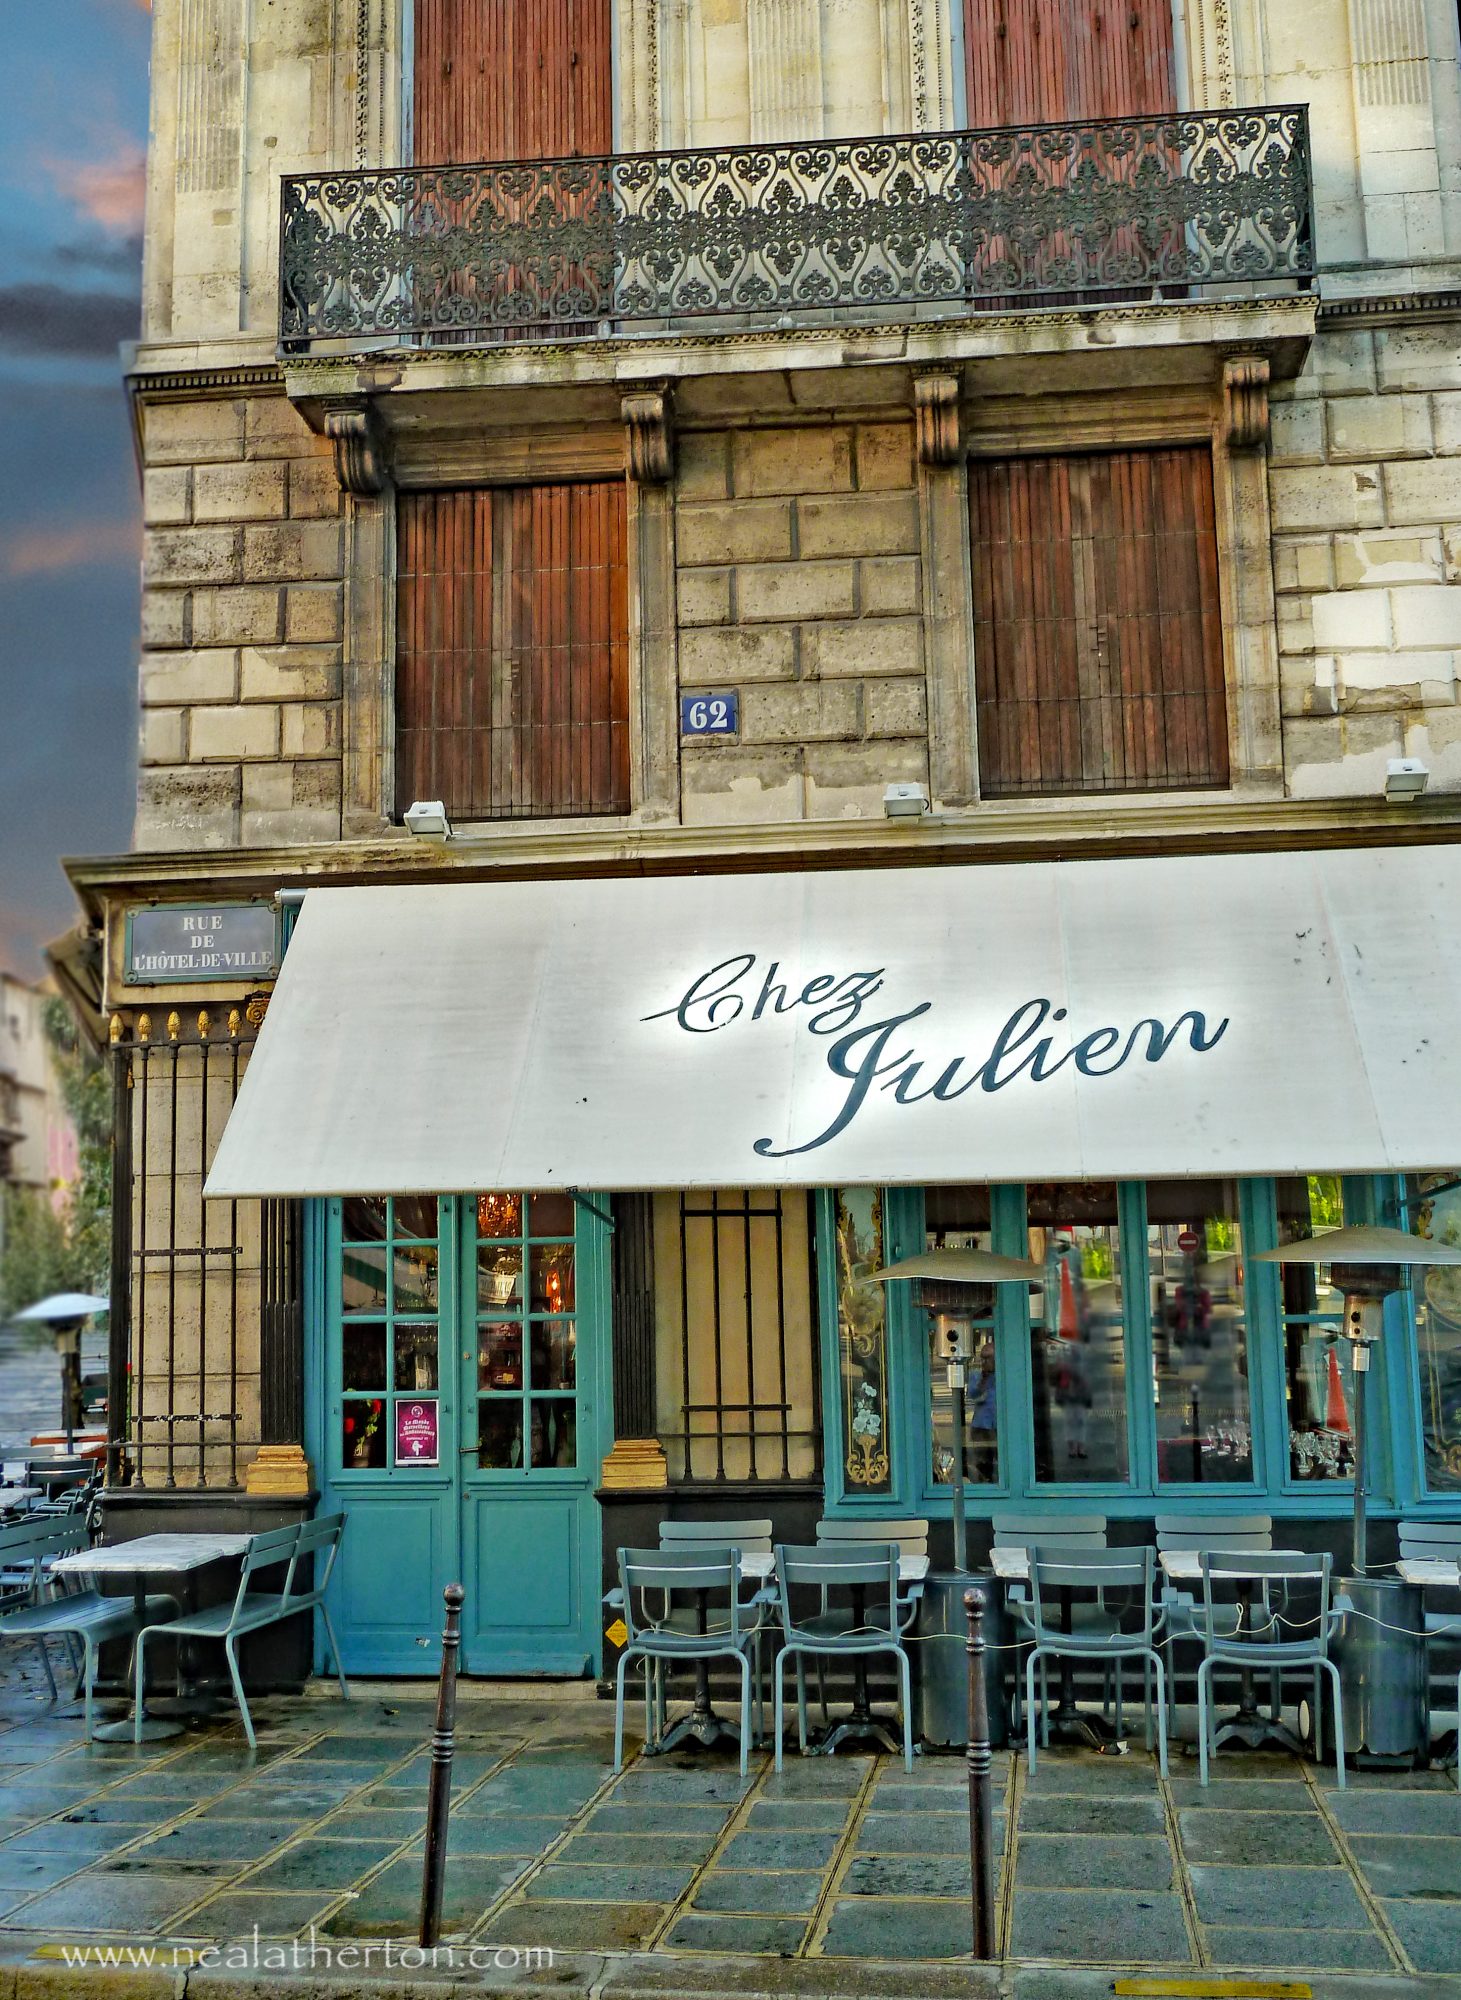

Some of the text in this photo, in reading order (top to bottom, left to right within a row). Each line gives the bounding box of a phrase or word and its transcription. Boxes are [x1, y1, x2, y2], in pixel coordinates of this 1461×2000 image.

[690, 700, 728, 729] 62
[183, 915, 223, 931] RUE
[191, 935, 215, 949] DE
[639, 953, 886, 1035] Chez
[752, 998, 1230, 1158] Julien
